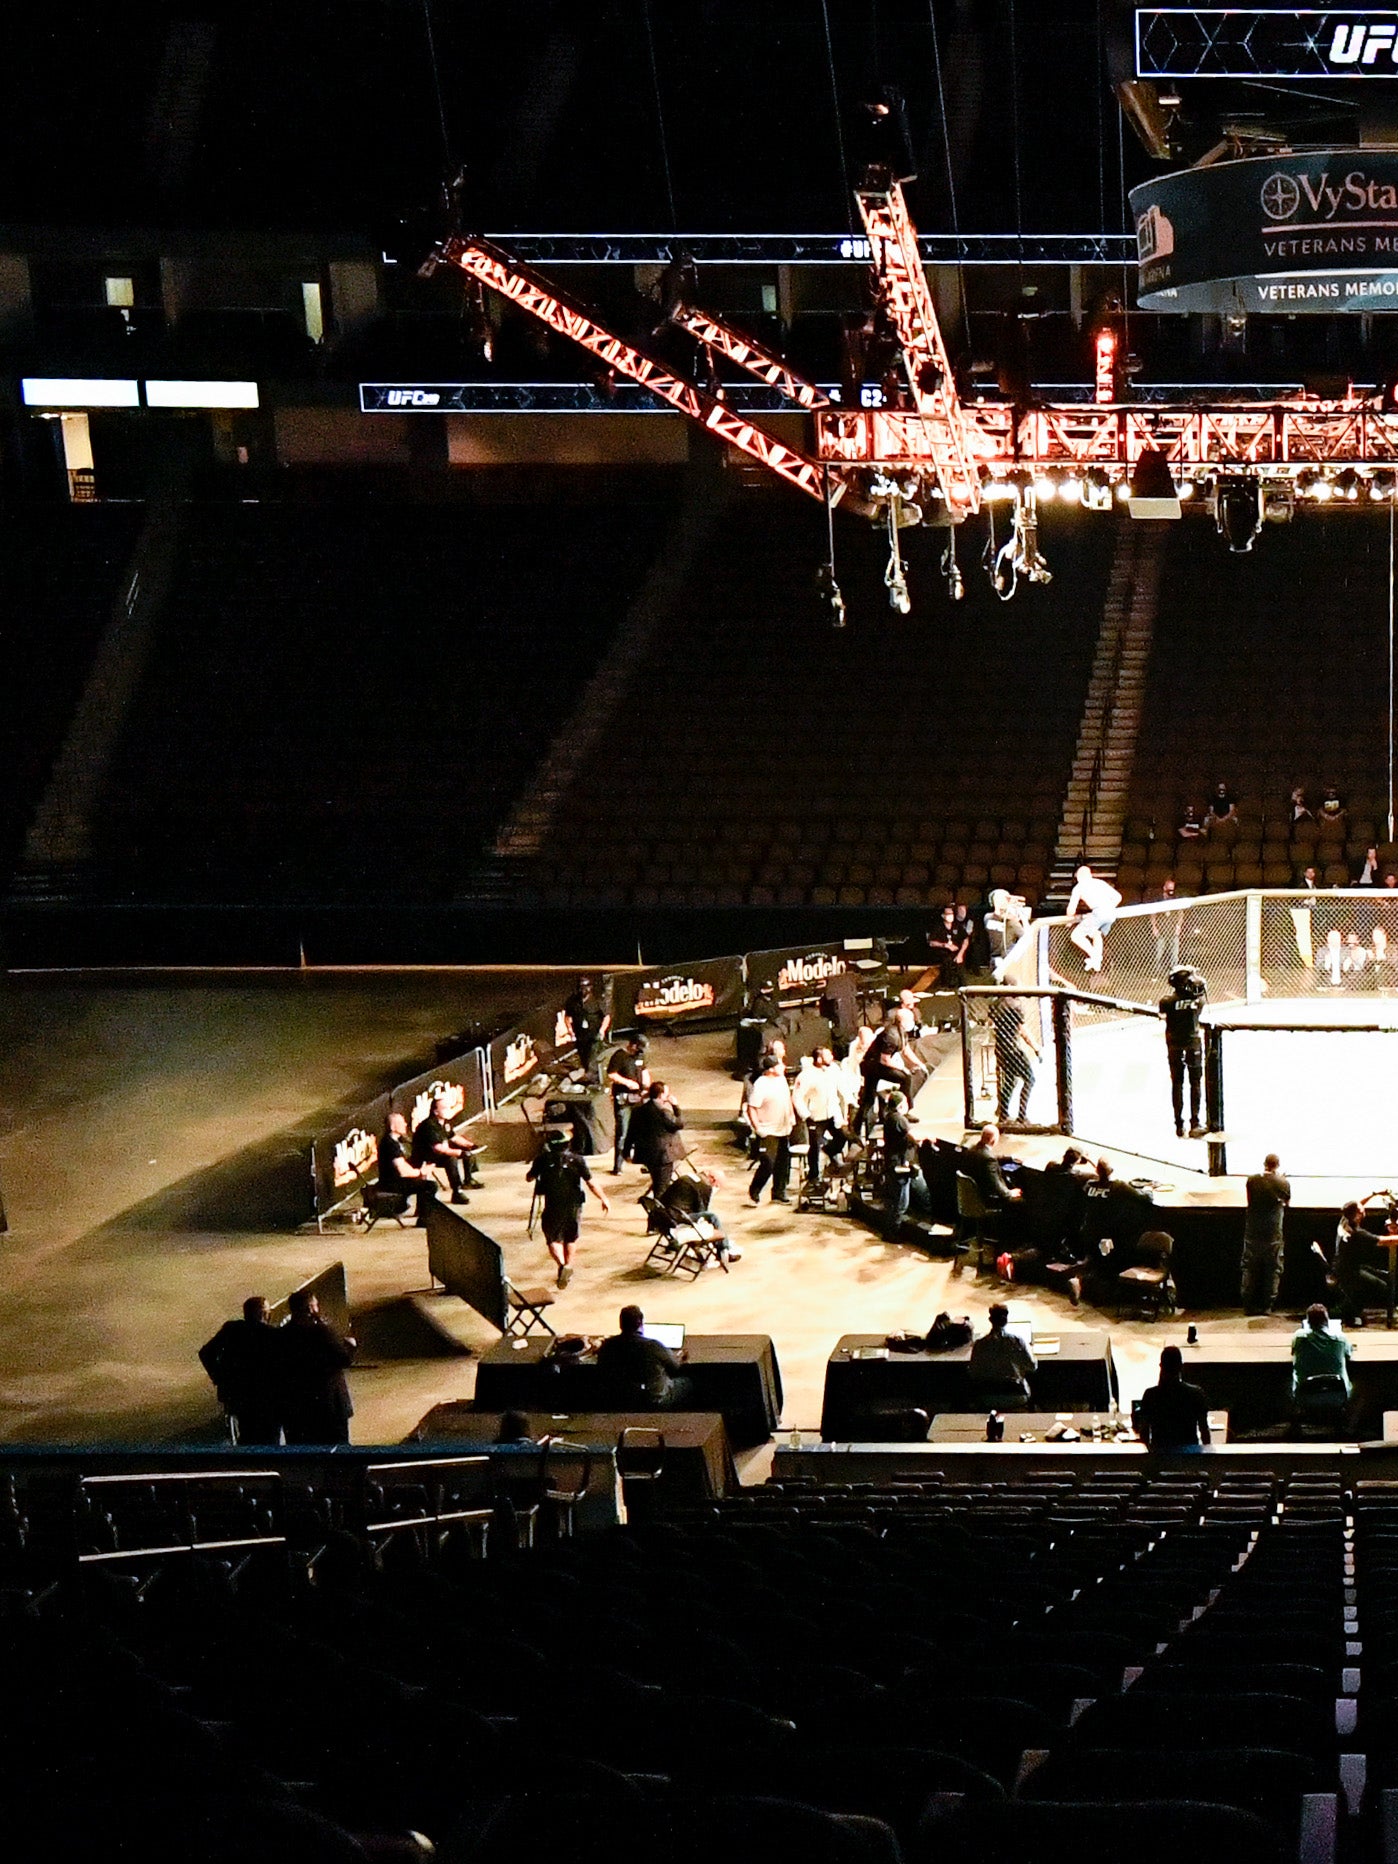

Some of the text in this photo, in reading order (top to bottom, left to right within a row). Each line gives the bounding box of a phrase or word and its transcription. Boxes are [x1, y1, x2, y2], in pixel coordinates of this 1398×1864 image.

[1264, 237, 1366, 257] VETERANS
[1258, 283, 1340, 300] VETERANS
[1087, 1187, 1111, 1199] UFC
